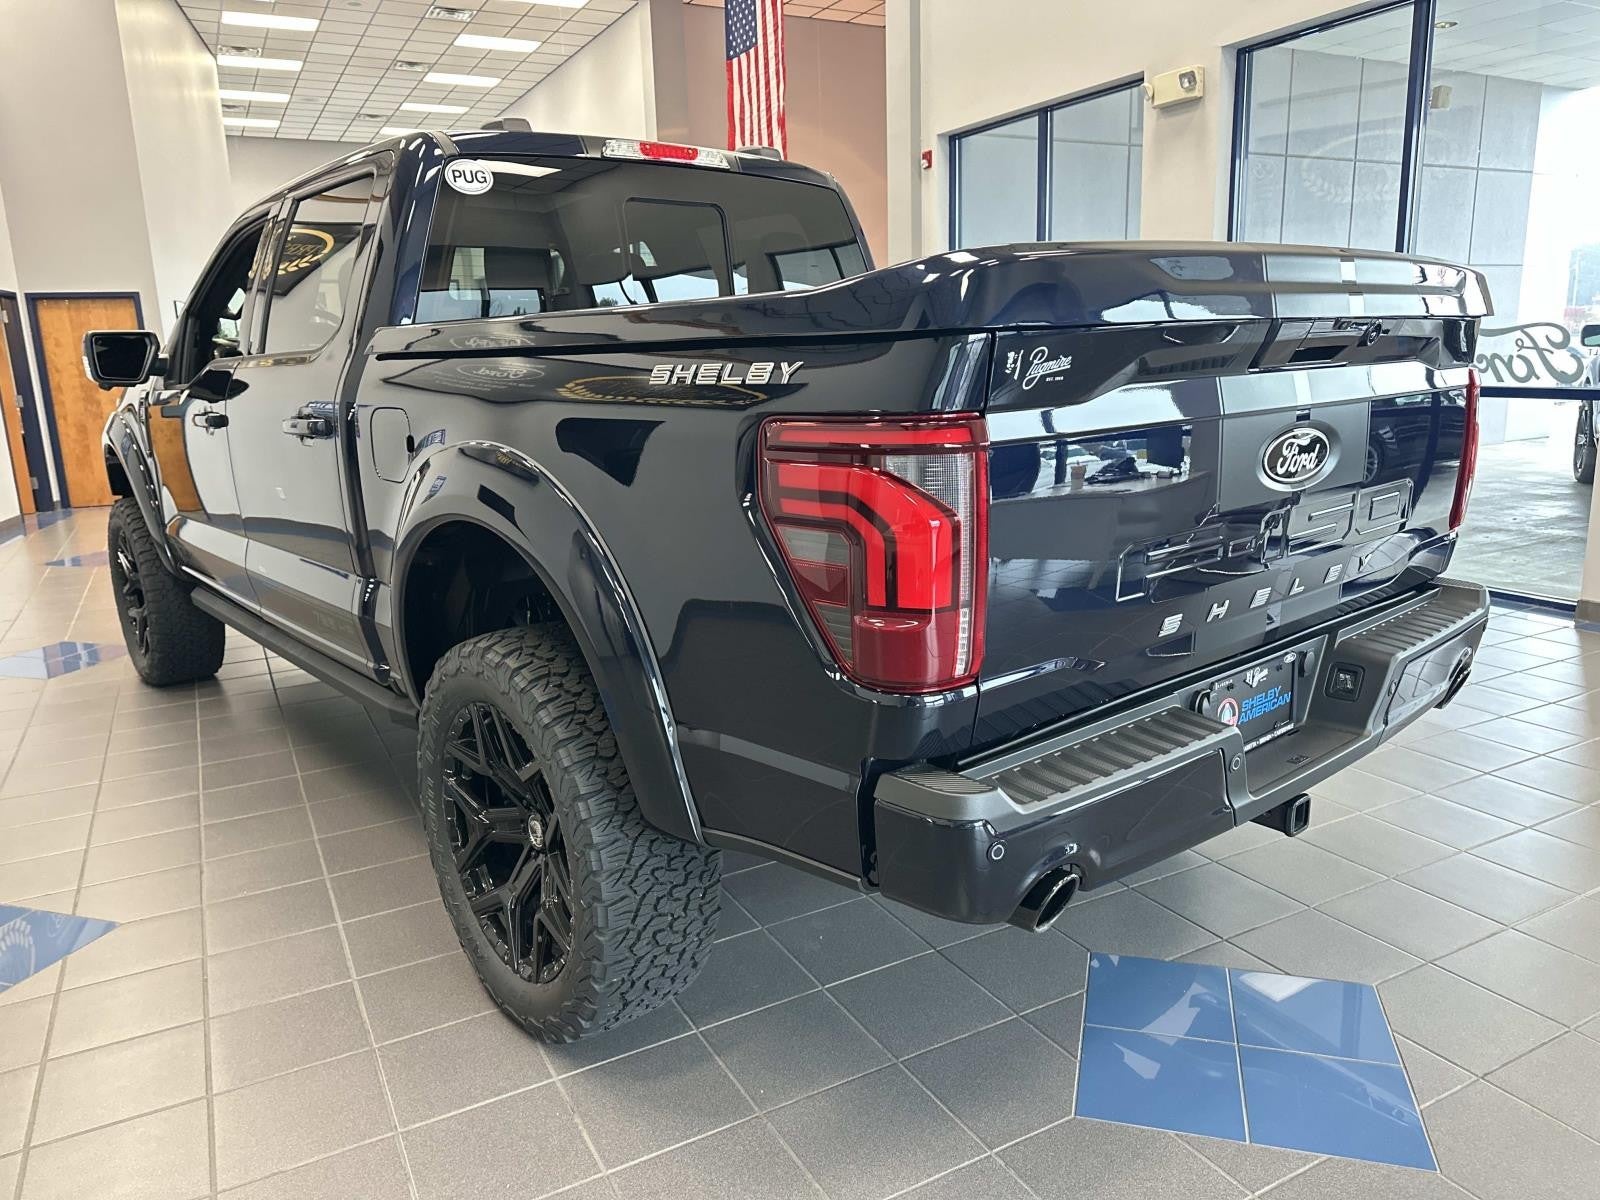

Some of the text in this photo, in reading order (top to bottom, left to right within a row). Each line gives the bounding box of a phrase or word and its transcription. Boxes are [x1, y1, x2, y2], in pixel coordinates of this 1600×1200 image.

[451, 169, 488, 184] PUG
[649, 361, 804, 385] SHELBY
[1022, 346, 1072, 390] Pugmire
[1276, 437, 1320, 475] Ford
[1115, 478, 1415, 602] F-150
[1158, 553, 1374, 638] SHELBY
[1238, 692, 1291, 724] AMERICAN
[1242, 685, 1282, 711] SHELBY
